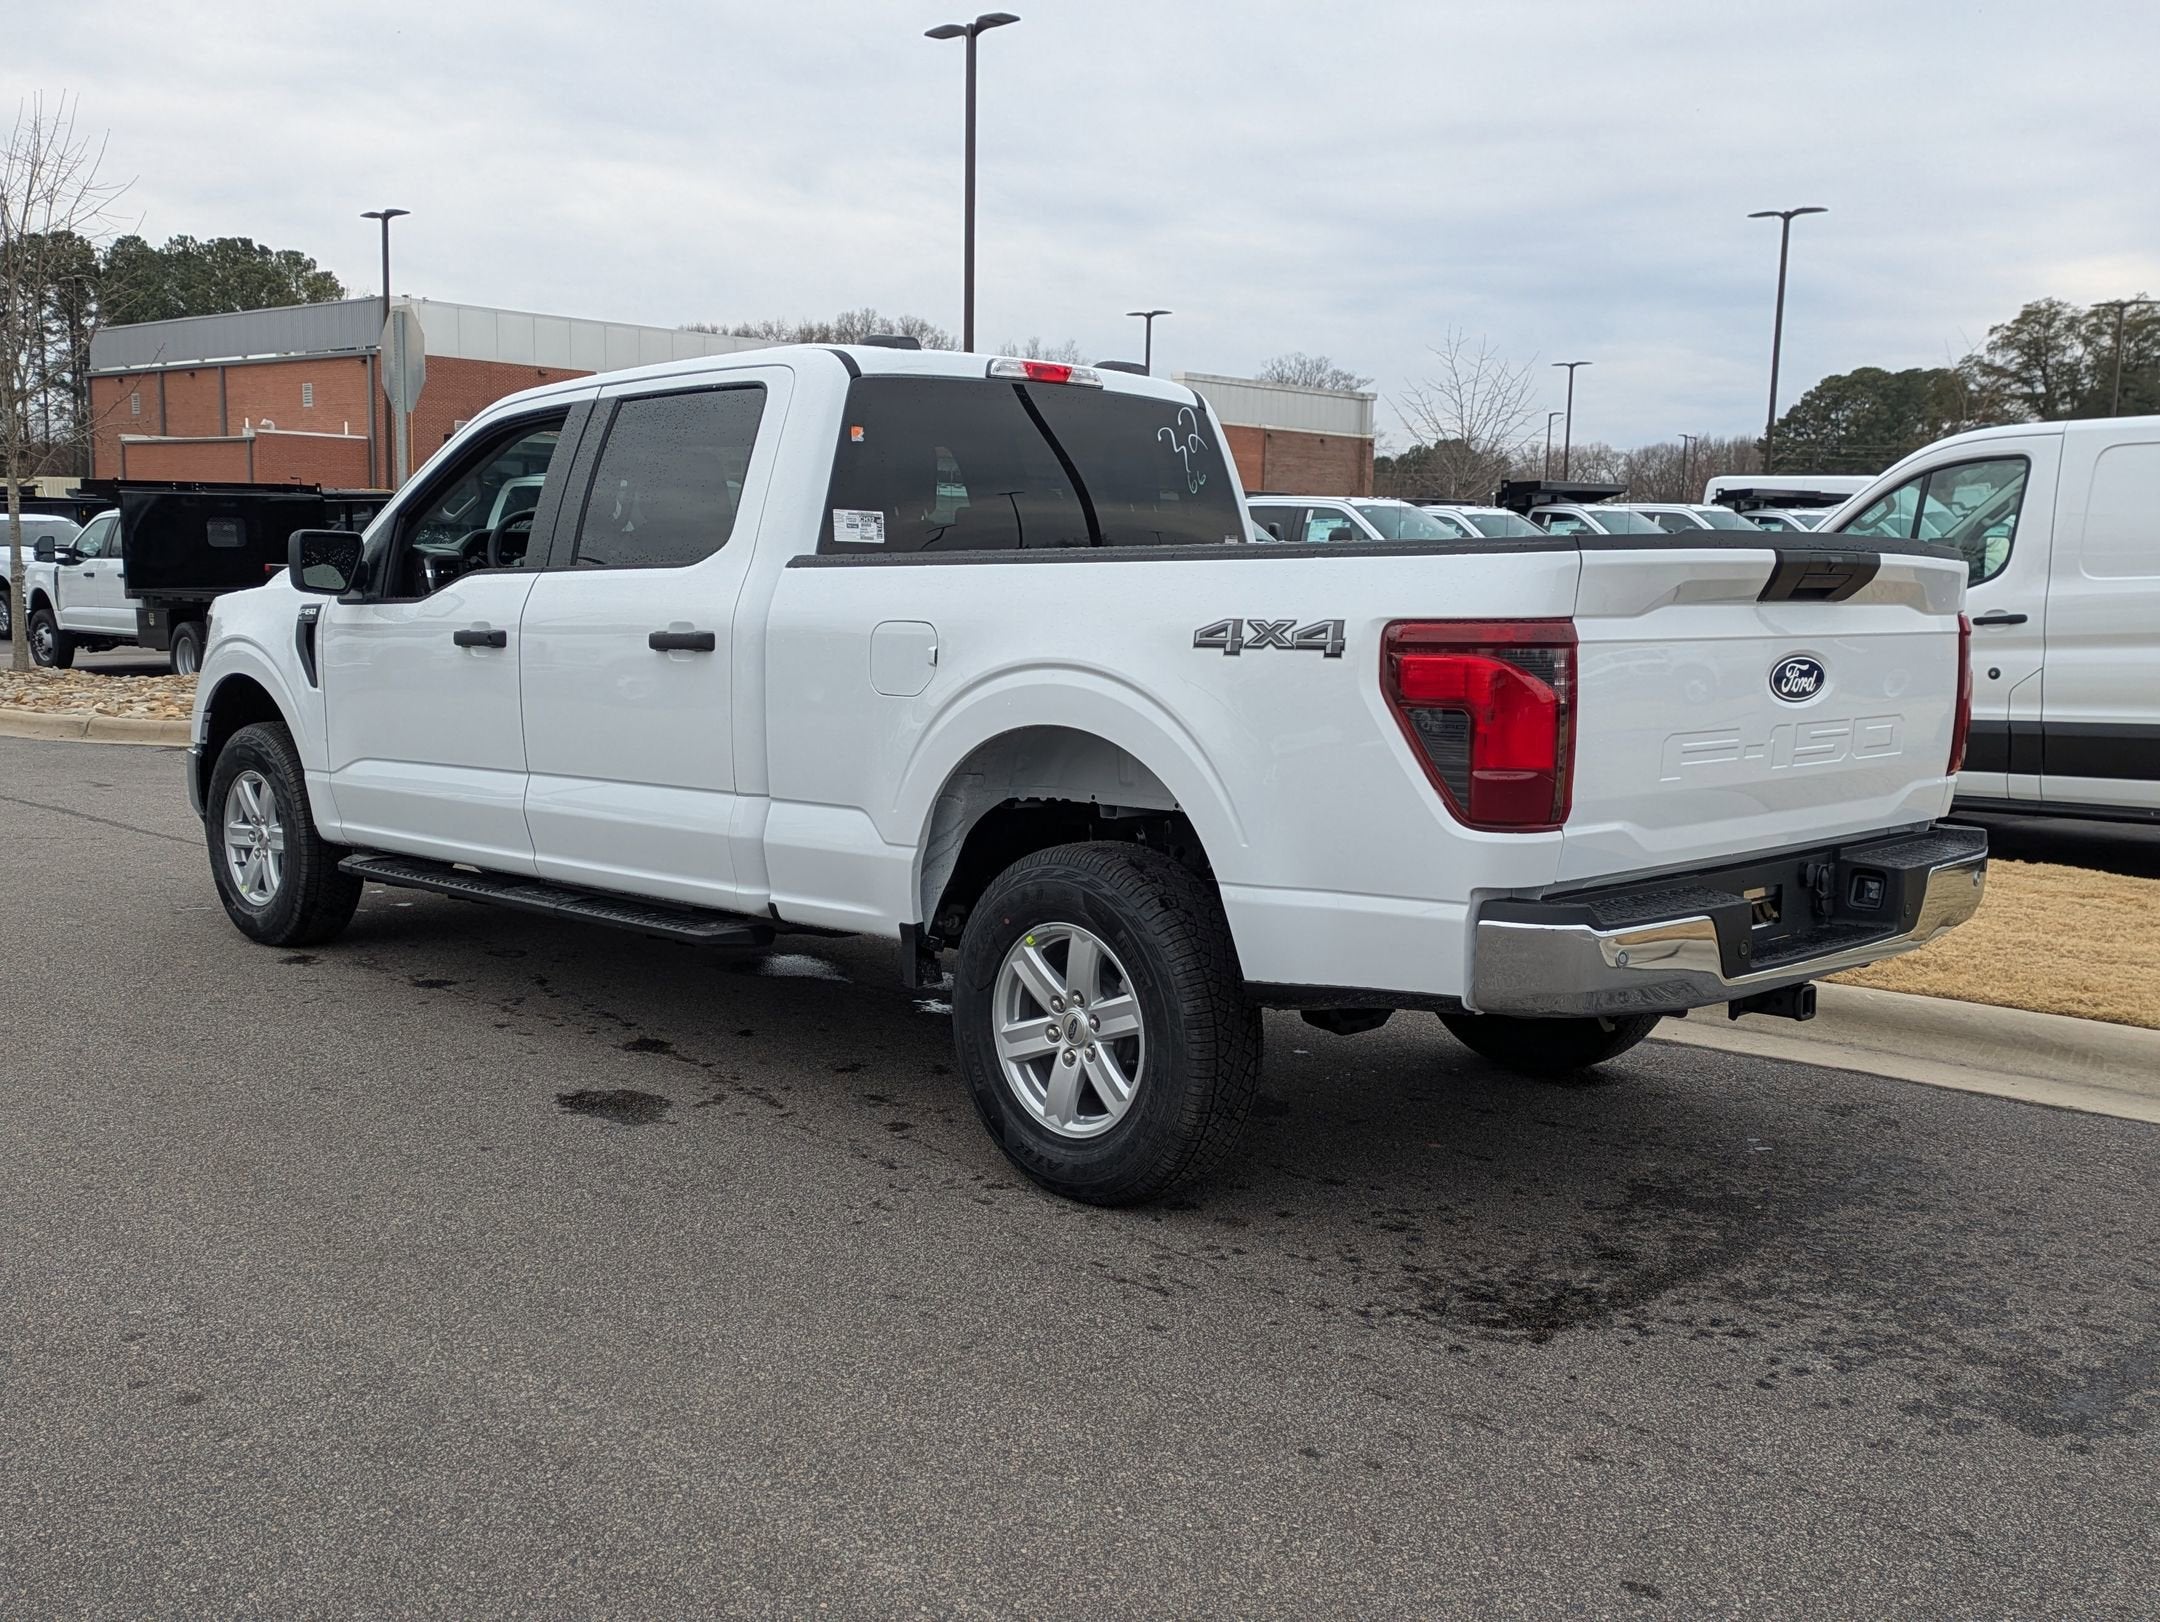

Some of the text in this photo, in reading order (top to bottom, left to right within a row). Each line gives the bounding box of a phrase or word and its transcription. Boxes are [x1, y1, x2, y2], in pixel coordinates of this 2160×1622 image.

[1157, 406, 1208, 473] 32
[1781, 662, 1818, 694] Ford
[1660, 714, 1906, 782] F-150
